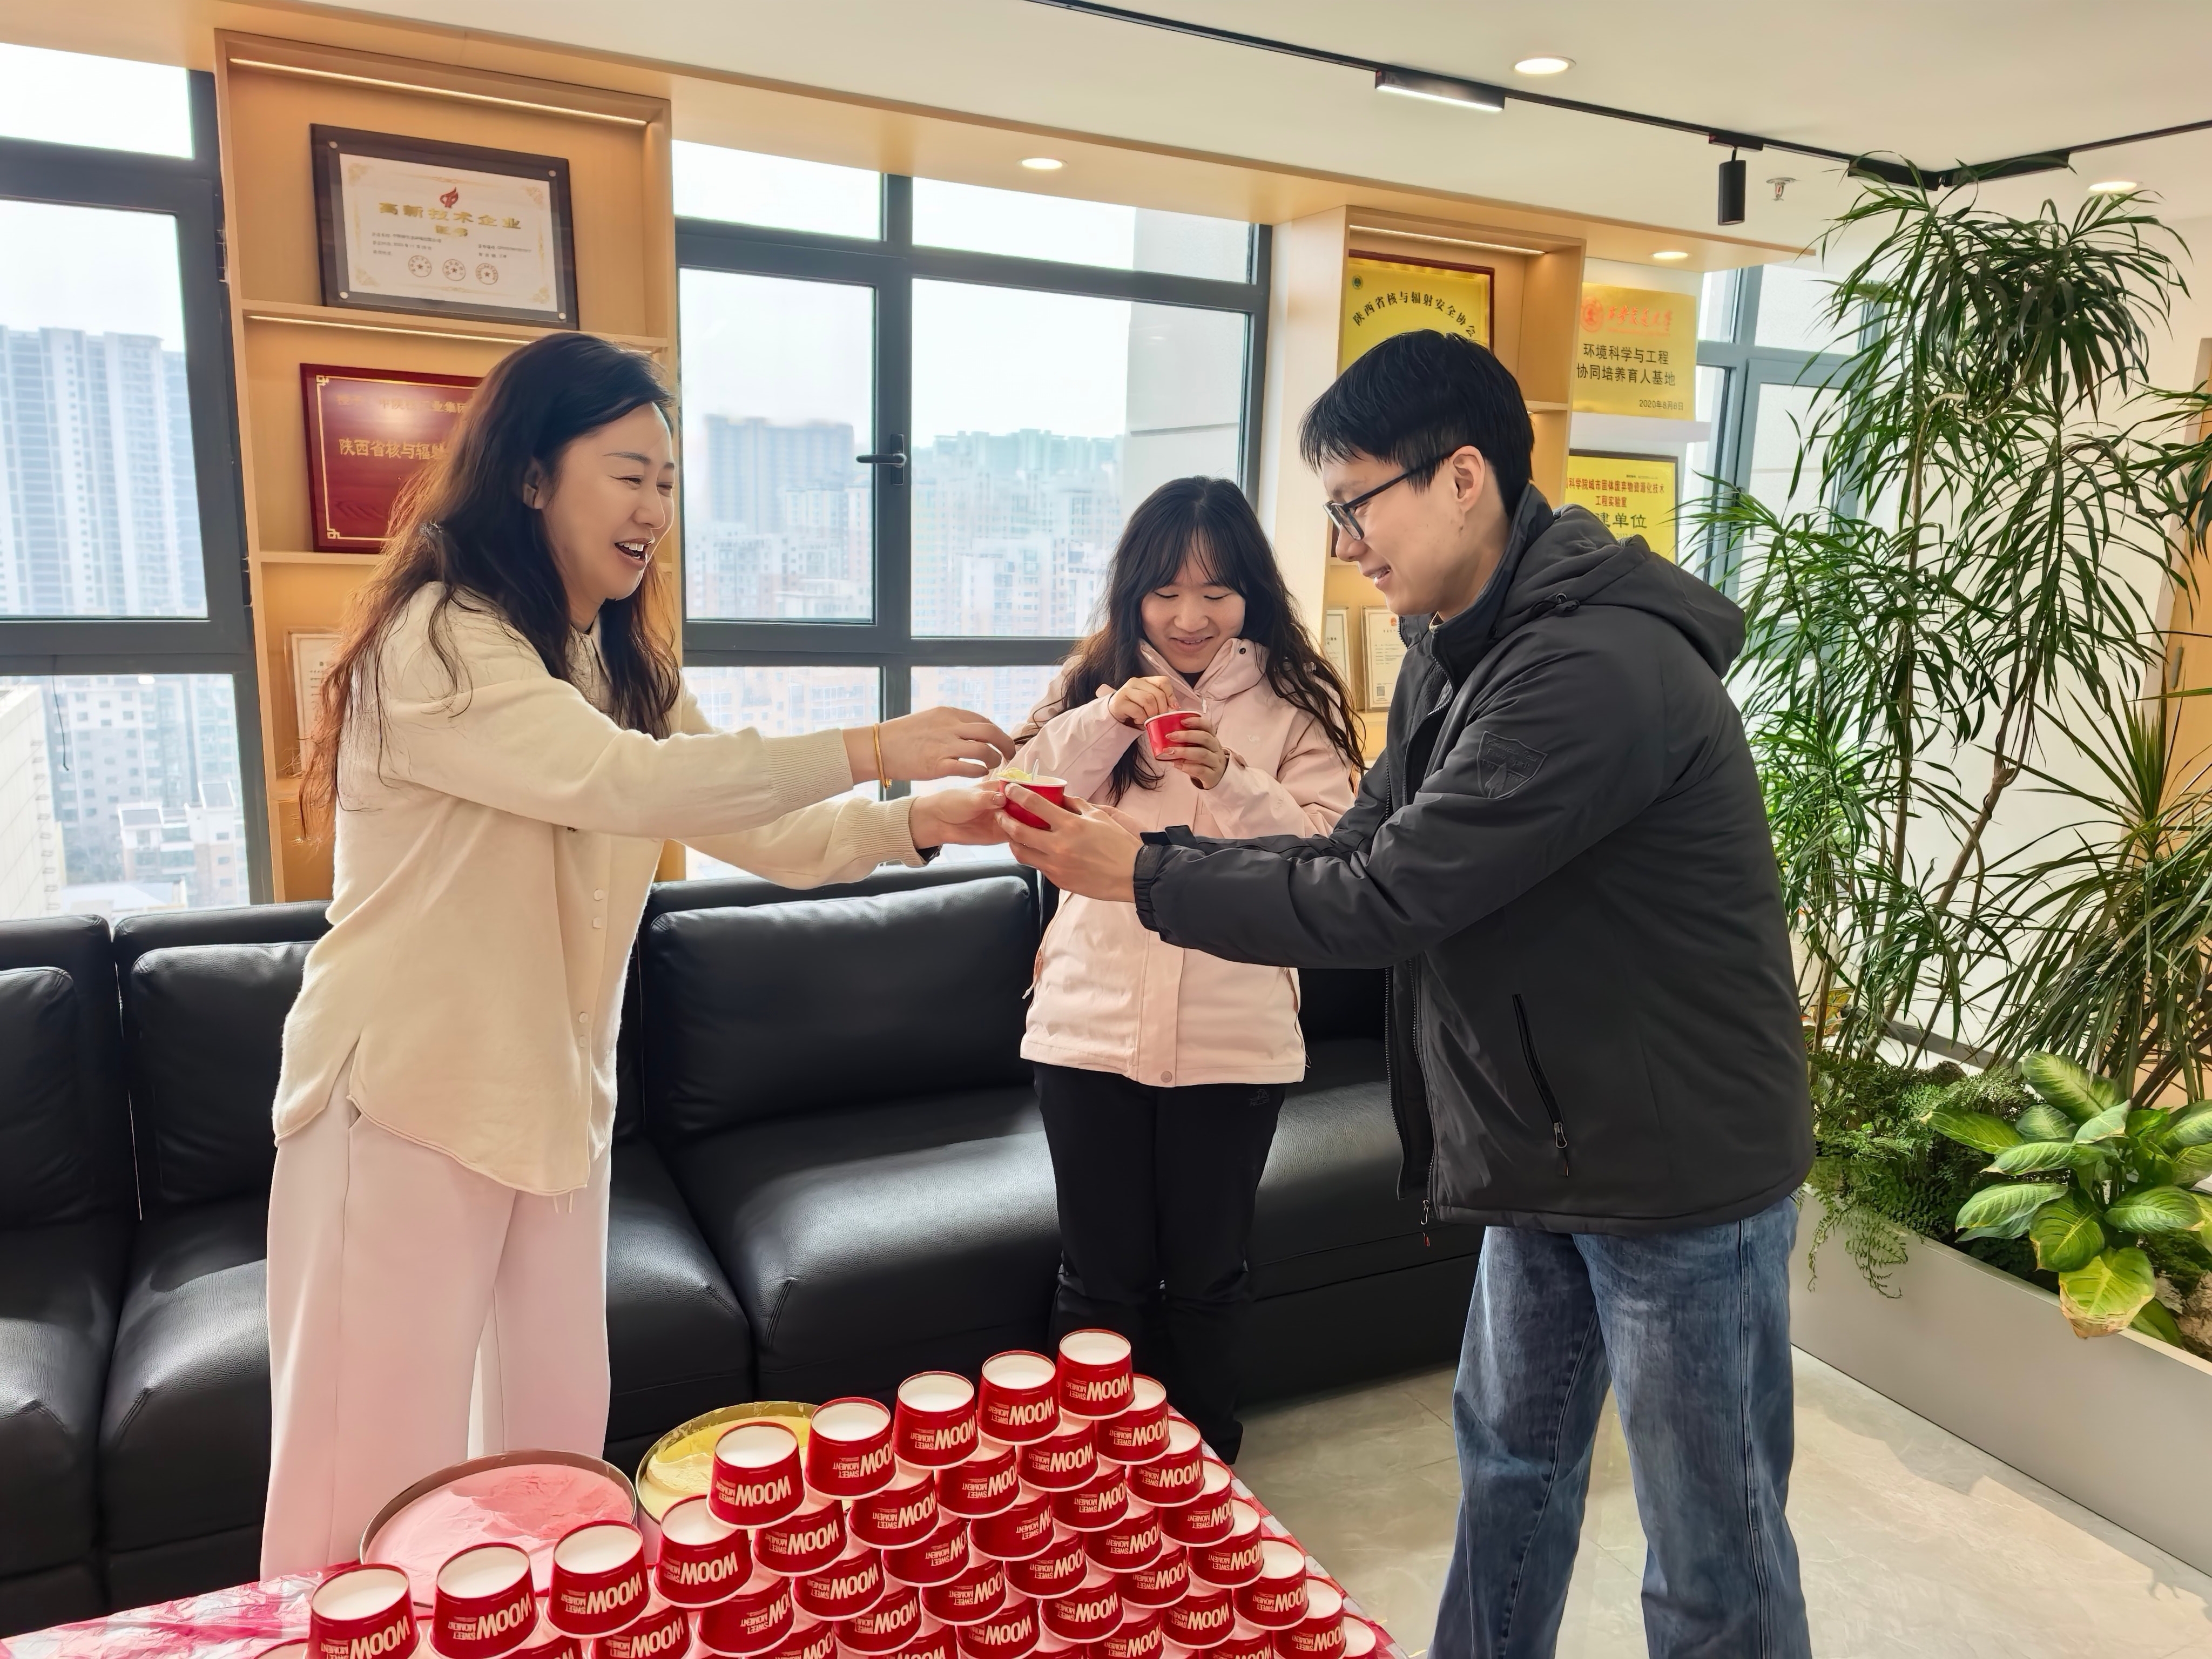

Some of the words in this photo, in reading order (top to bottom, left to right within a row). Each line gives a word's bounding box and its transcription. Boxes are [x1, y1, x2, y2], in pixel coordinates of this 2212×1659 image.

[1352, 291, 1475, 337] 陕西省核与辐射安全协会
[1583, 343, 1669, 365] 环境科学与工程
[1576, 363, 1675, 386] 协同培养育人基地
[1086, 1373, 1130, 1401] WOOW
[1009, 1397, 1054, 1426] WOOW
[934, 1415, 976, 1450] WOOW
[1050, 1441, 1093, 1472] WOOW
[1159, 1459, 1201, 1488] WOOW
[735, 1475, 791, 1507] WOOW
[787, 1519, 839, 1555] WOOW
[680, 1551, 738, 1585] WOOW
[830, 1563, 879, 1600] WOOW
[587, 1572, 642, 1614] WOOW
[1075, 1591, 1118, 1622] WOOW
[476, 1592, 531, 1640] WOOW
[873, 1596, 918, 1634] WOOW
[984, 1615, 1032, 1645] WOOW
[1188, 1602, 1229, 1630] WOOW
[350, 1615, 410, 1659] WOOW
[630, 1616, 684, 1658] WOOW
